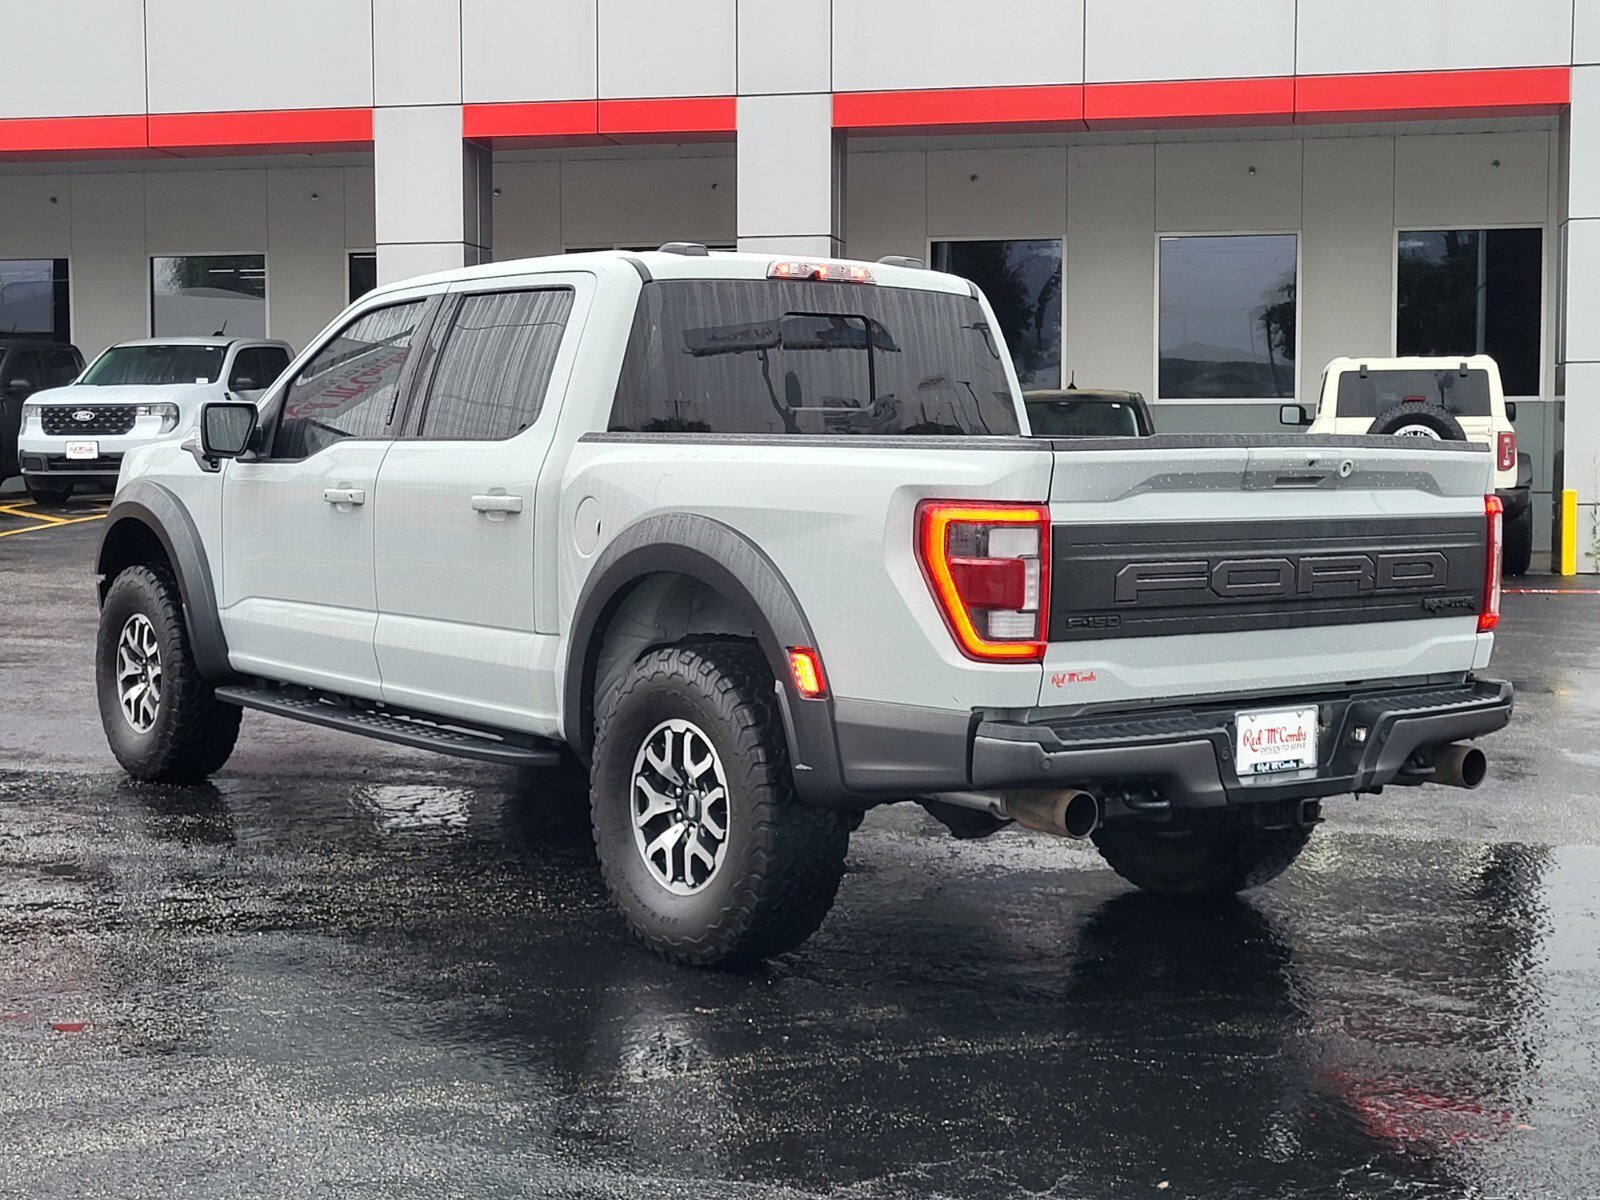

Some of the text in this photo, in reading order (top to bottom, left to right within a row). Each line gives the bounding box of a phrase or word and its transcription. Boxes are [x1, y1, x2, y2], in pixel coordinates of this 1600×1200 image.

[1114, 551, 1448, 603] FORD
[1066, 614, 1121, 632] F-150
[1051, 673, 1066, 688] Red
[1243, 725, 1306, 752] Red McCombs
[1260, 746, 1281, 754] DRIVEN
[1290, 742, 1306, 750] SERVE
